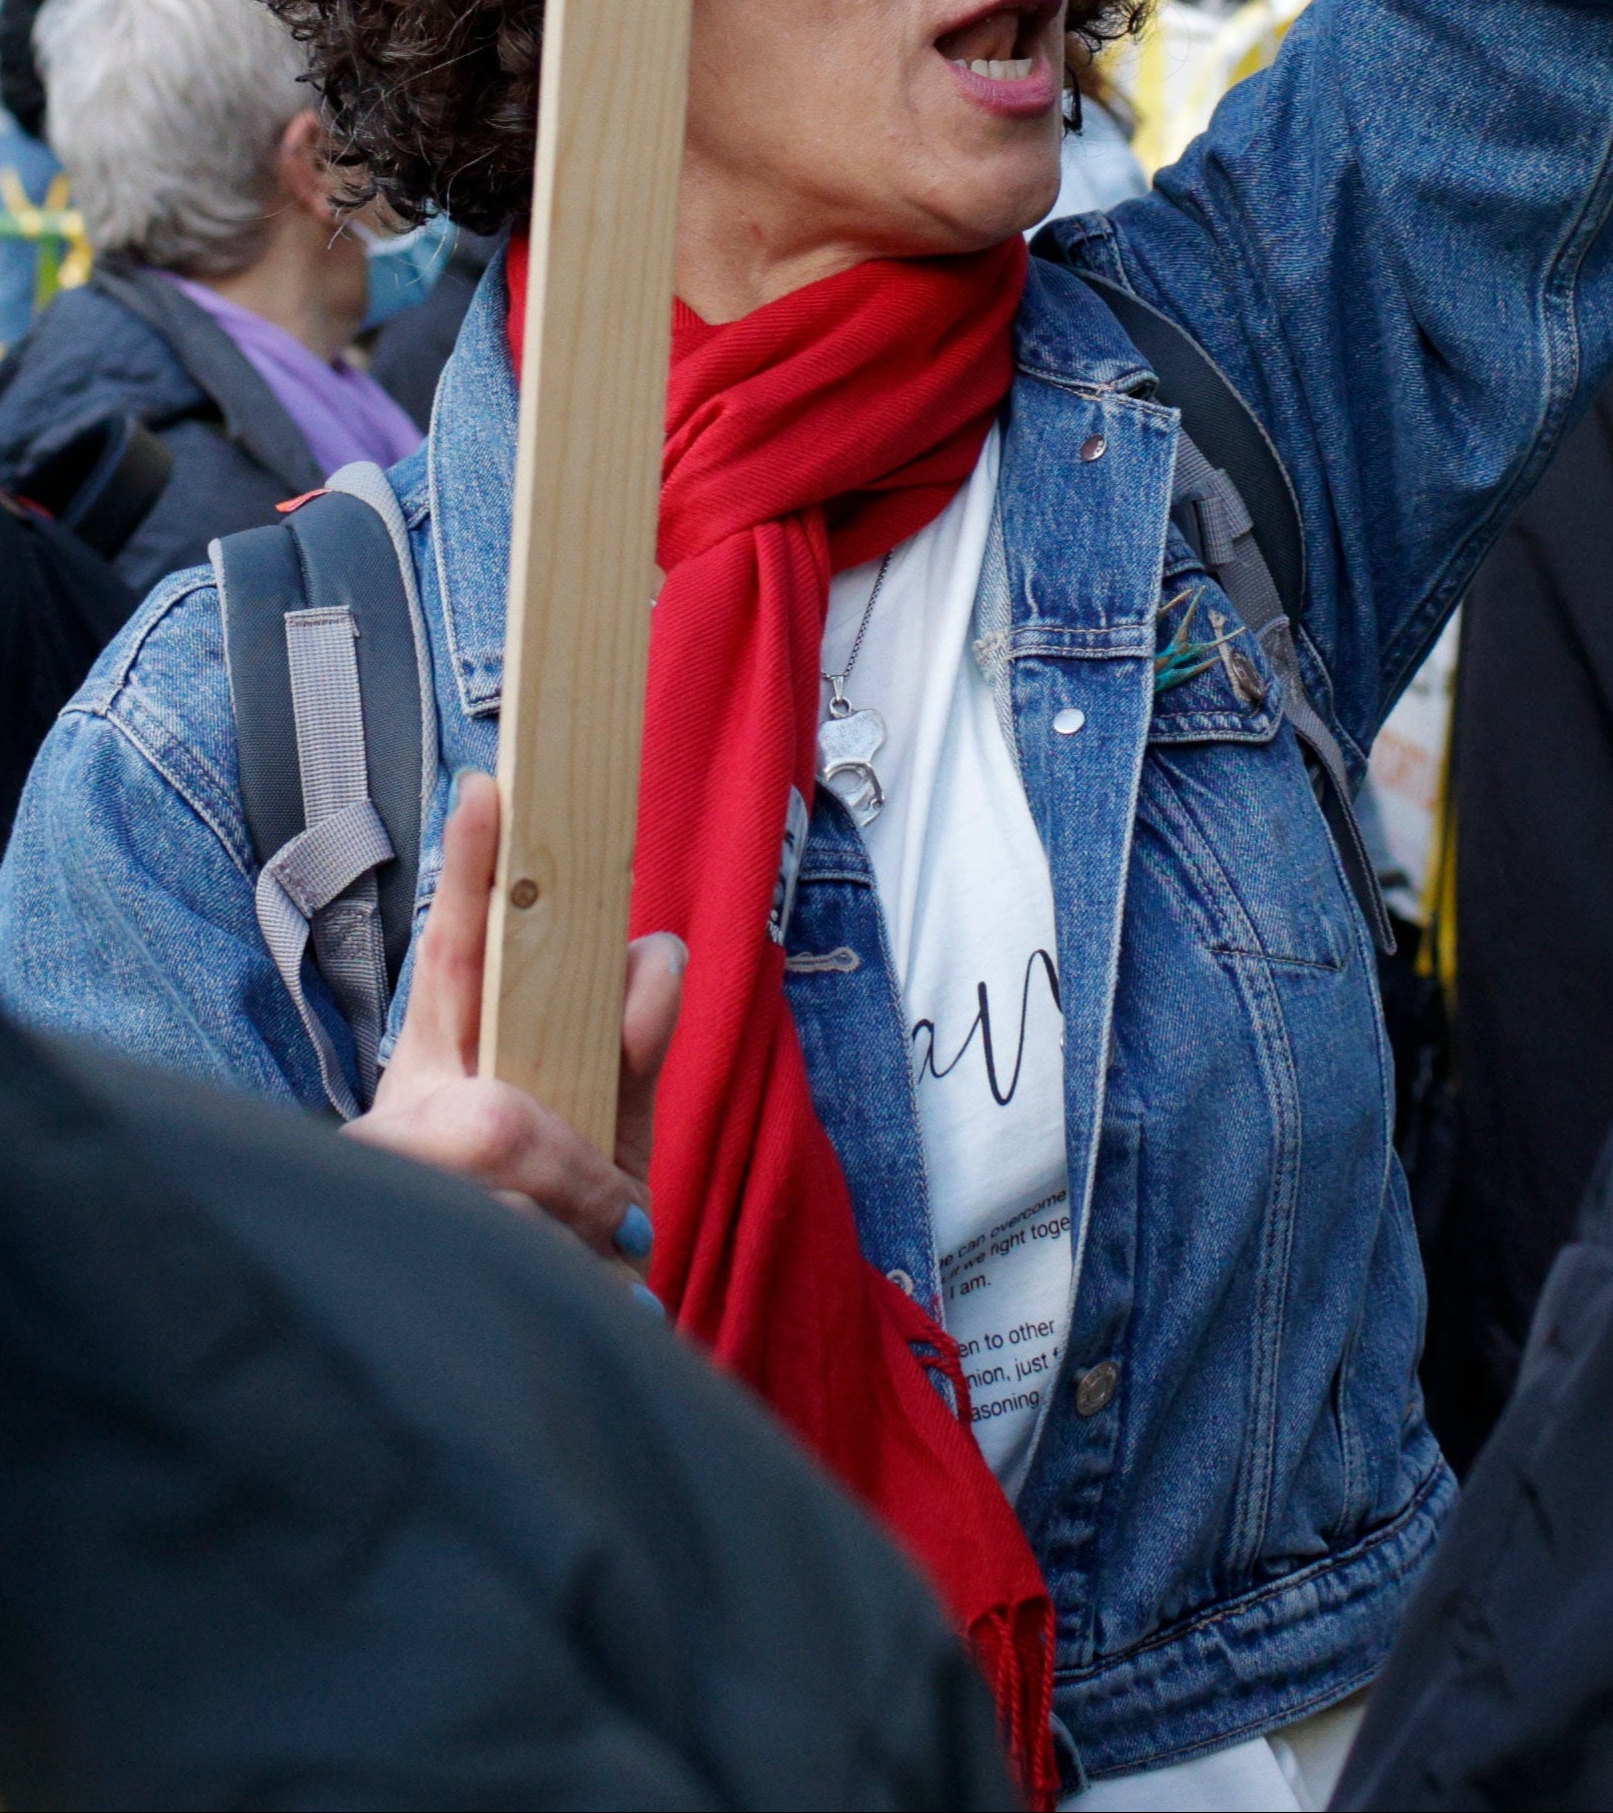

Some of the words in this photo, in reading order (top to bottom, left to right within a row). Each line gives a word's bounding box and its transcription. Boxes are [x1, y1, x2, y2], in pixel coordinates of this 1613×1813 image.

[990, 1190, 1068, 1239] overcome
[959, 1274, 992, 1296] am.
[984, 1333, 1004, 1351] to
[1008, 1319, 1056, 1345] other
[1014, 1352, 1049, 1382] just
